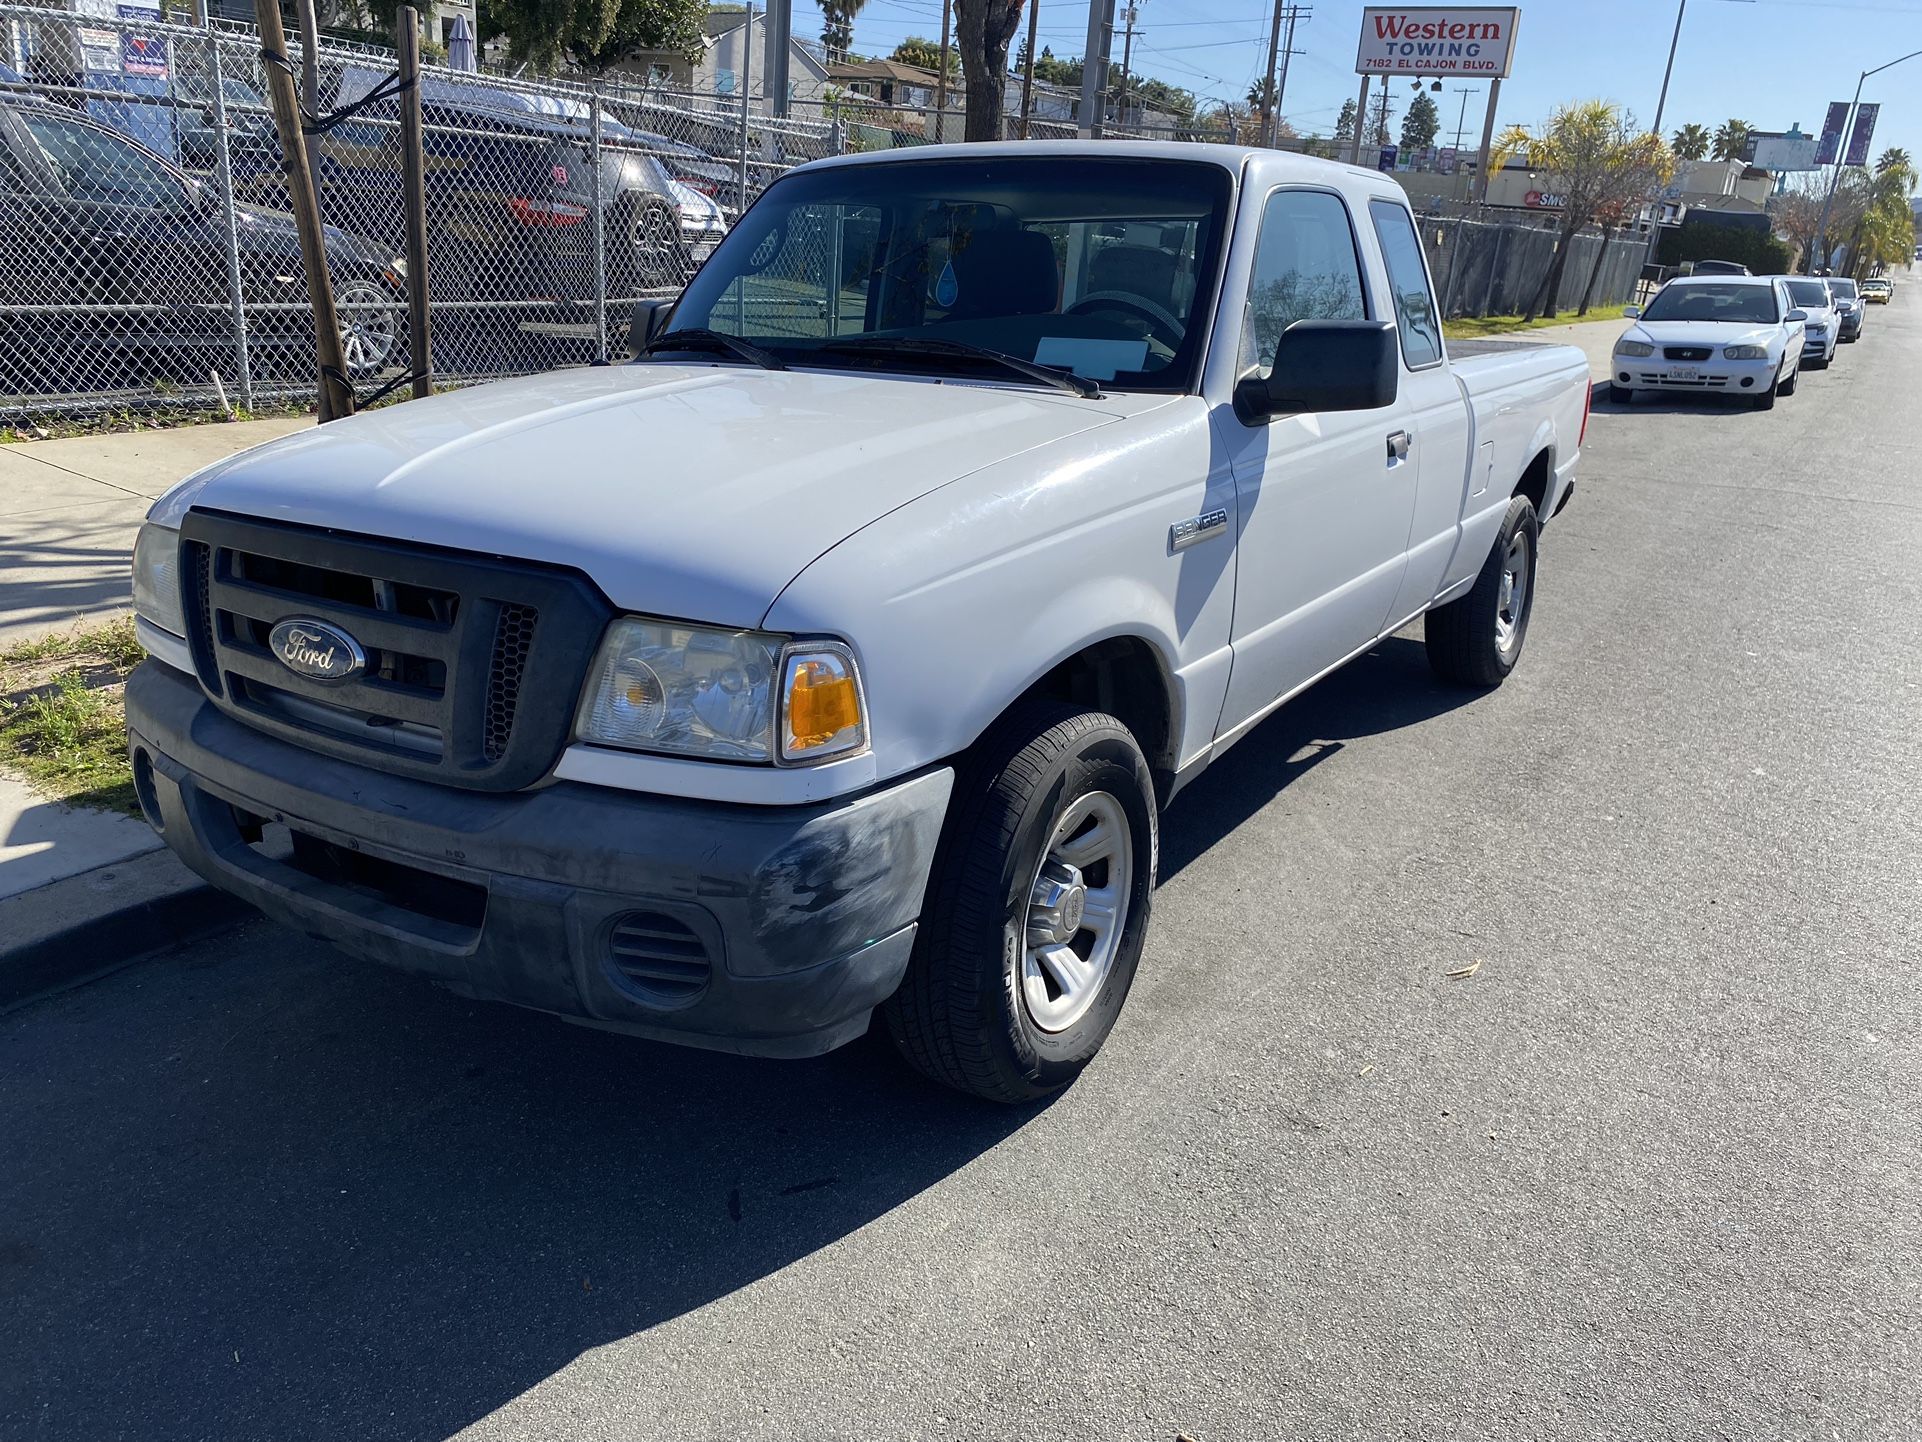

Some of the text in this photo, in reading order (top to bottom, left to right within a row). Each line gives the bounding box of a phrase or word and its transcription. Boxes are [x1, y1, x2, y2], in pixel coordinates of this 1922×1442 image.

[1374, 15, 1500, 40] Western
[1386, 42, 1481, 57] TOWING
[1365, 59, 1498, 70] 7182 EL CAJON BLVD.
[1173, 510, 1228, 539] RANGER
[284, 629, 335, 670] Ford
